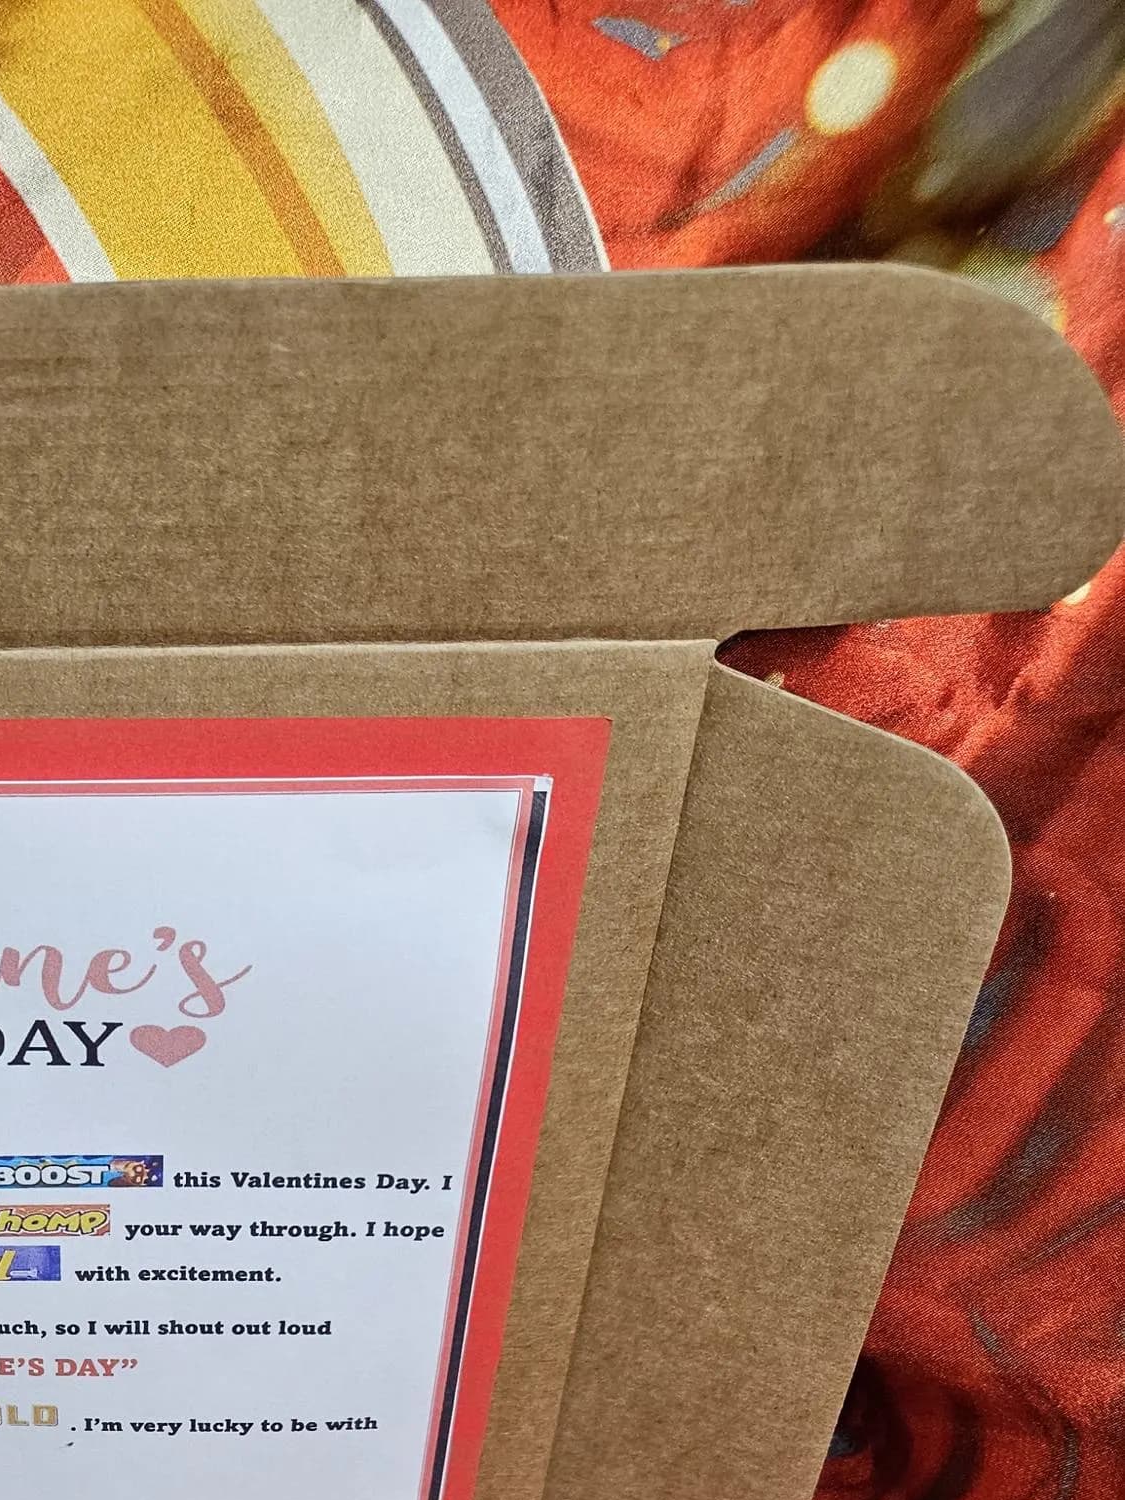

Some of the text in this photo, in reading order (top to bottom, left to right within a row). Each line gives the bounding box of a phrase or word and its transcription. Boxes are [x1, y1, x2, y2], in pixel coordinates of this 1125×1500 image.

[172, 1171, 222, 1189] this
[229, 1171, 367, 1190] Valentines
[375, 1173, 431, 1195] Day.
[440, 1174, 454, 1191] I
[124, 1223, 183, 1242] your
[188, 1224, 243, 1242] way
[249, 1220, 357, 1242] through.
[364, 1221, 377, 1237] I
[382, 1220, 445, 1242] hope
[74, 1265, 131, 1282] with
[137, 1265, 282, 1283] excitement.
[54, 1323, 81, 1336] so
[87, 1320, 98, 1336] I
[103, 1319, 151, 1336] will
[157, 1319, 225, 1336] shout
[231, 1320, 272, 1336] out
[277, 1319, 333, 1336] loud
[83, 1417, 124, 1432] I'm
[129, 1421, 184, 1437] very
[188, 1418, 255, 1437] lucky
[260, 1419, 284, 1433] to
[290, 1418, 318, 1433] be
[324, 1416, 379, 1432] with
